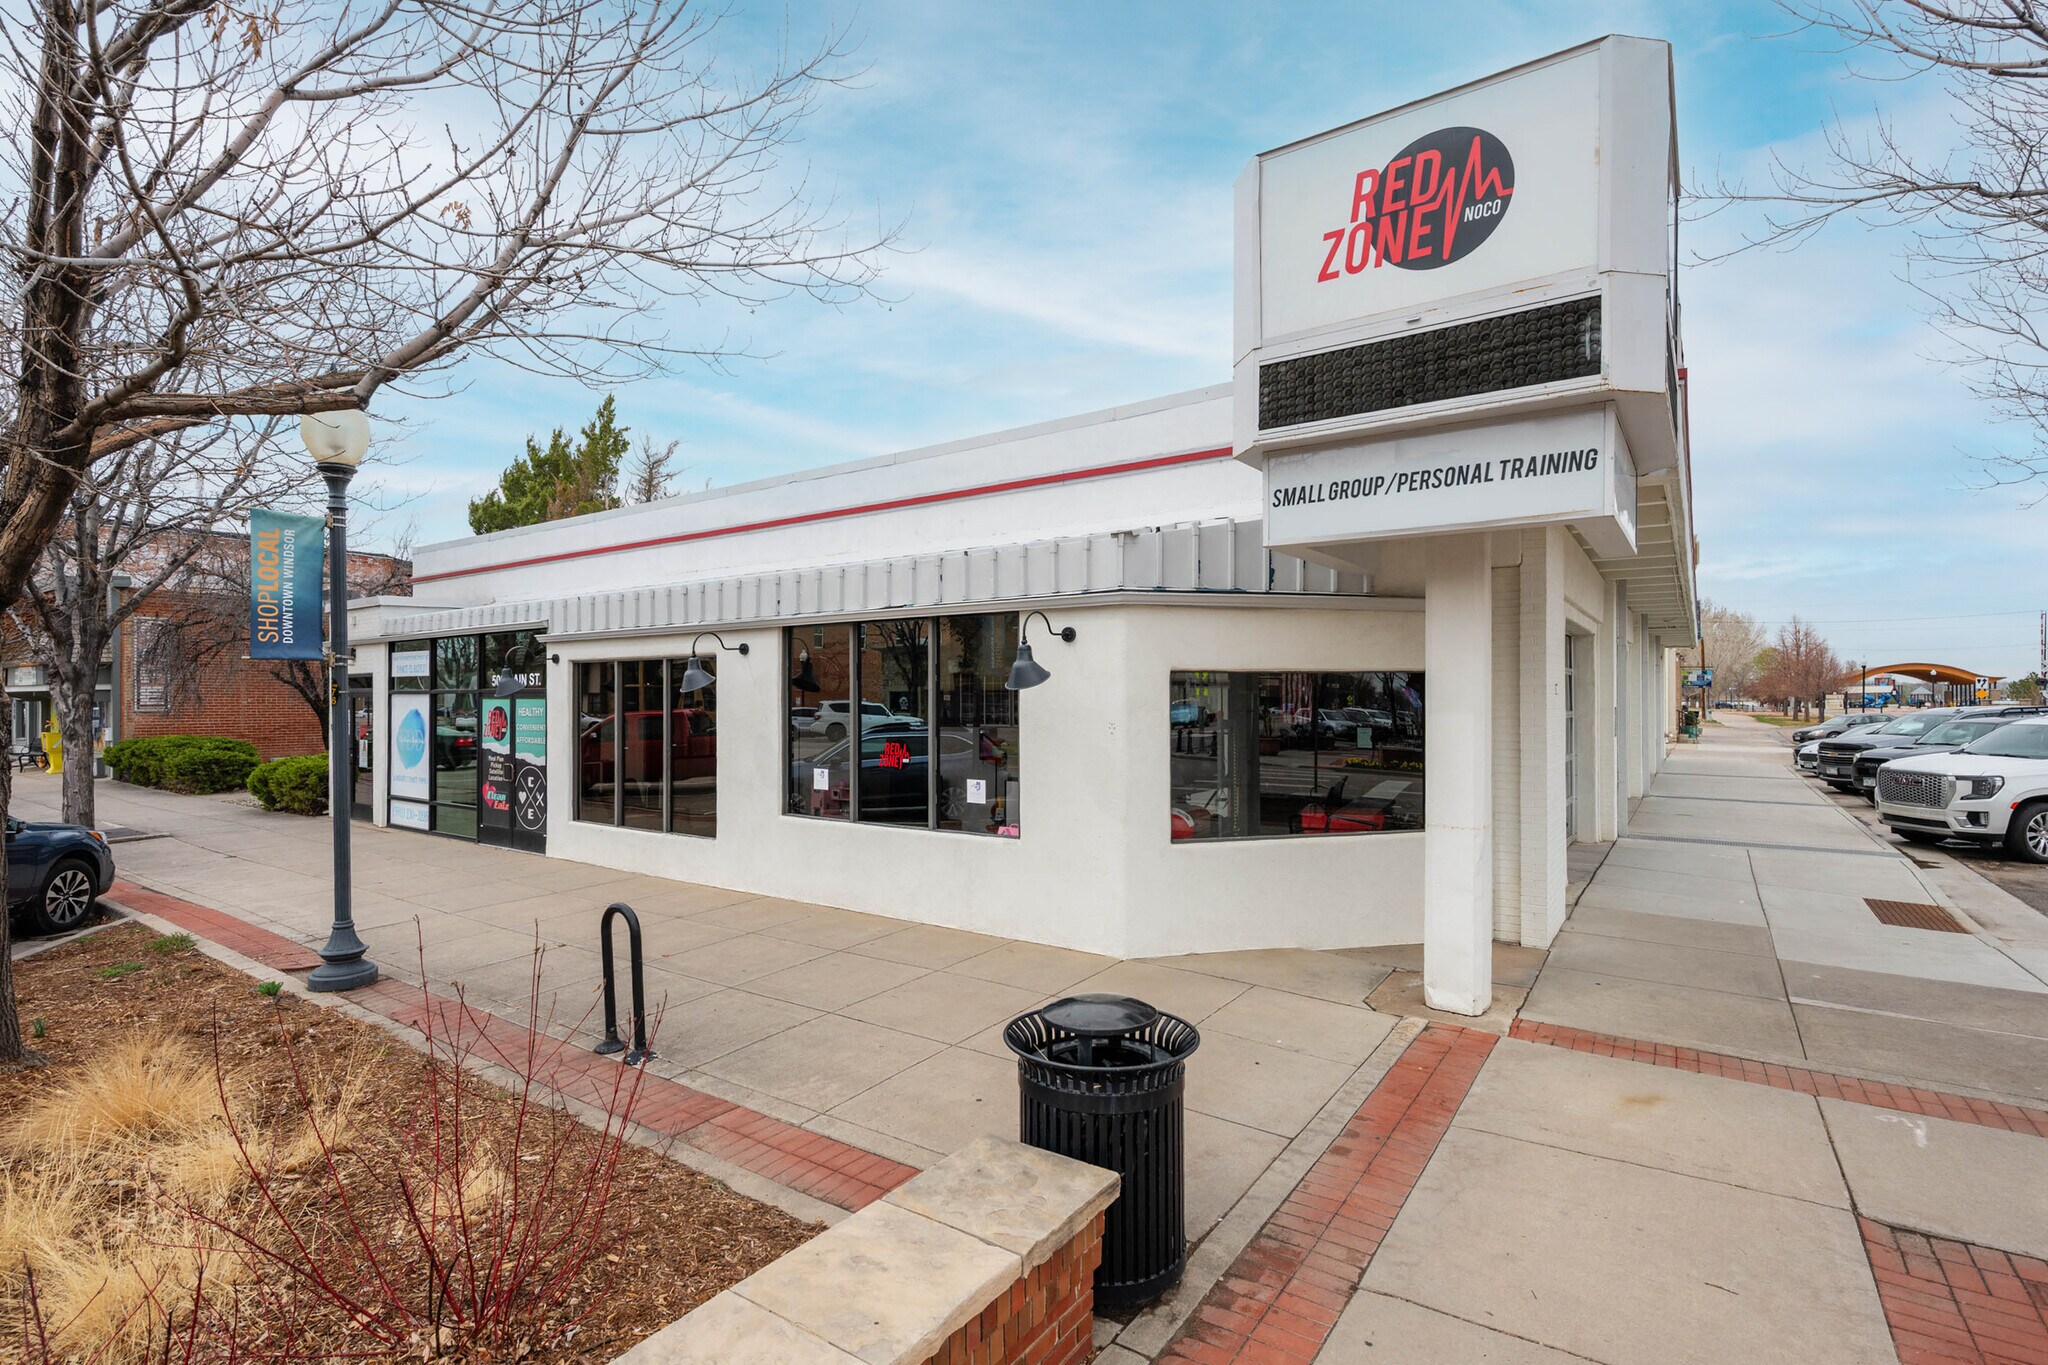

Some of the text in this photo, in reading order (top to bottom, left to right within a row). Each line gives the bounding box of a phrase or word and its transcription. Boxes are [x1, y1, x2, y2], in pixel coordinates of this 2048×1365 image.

[1351, 149, 1442, 224] RED
[1463, 198, 1502, 223] NOCO
[1317, 204, 1437, 284] ZONE
[1272, 483, 1326, 508] SMALL
[1499, 447, 1599, 481] TRAINING
[282, 529, 296, 644] DOWNTOWN WINDSOR
[528, 672, 541, 686] ST.
[488, 708, 500, 722] RED
[517, 707, 544, 717] HEALTHY
[483, 722, 500, 738] ZONE
[516, 723, 546, 731] CONVENIENT
[516, 736, 546, 745] AFFORDABLE
[885, 742, 900, 754] RED
[879, 754, 899, 767] ZONE
